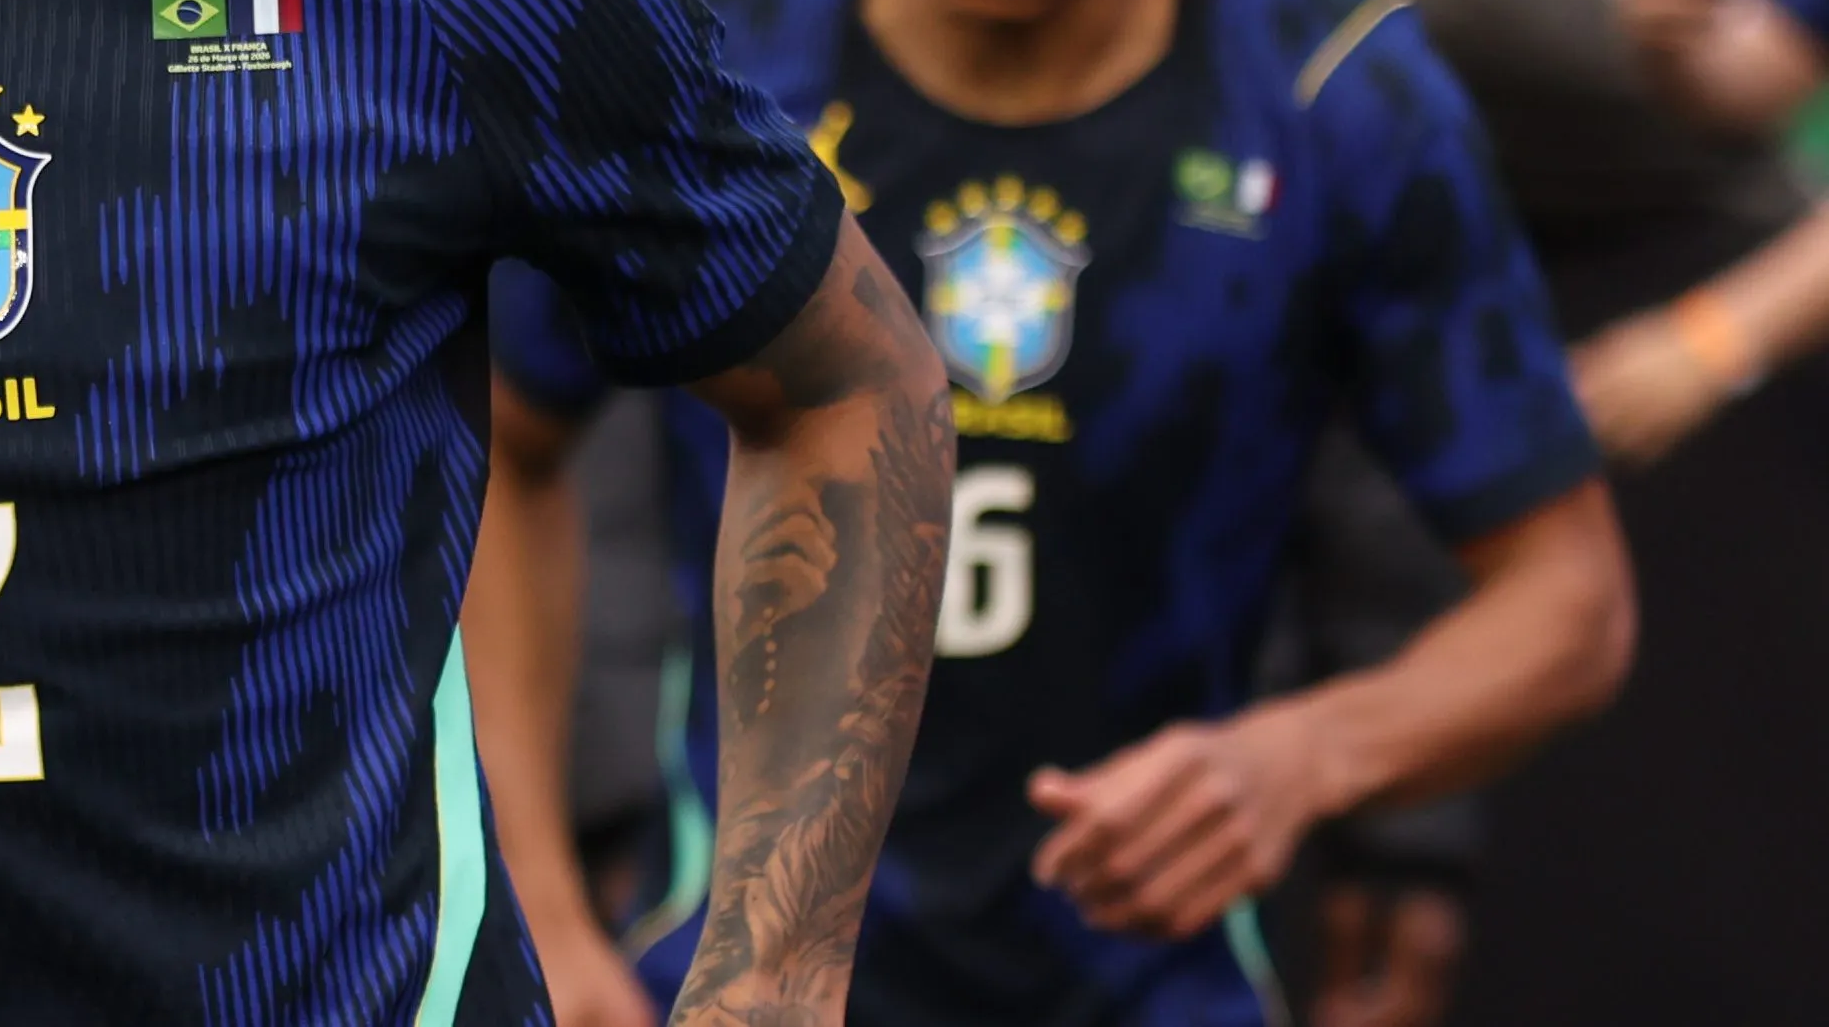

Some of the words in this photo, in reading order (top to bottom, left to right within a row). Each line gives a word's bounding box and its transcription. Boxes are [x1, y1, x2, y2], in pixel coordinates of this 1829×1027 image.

[190, 44, 221, 53] BRASIL
[200, 54, 211, 63] de
[238, 53, 249, 61] de
[167, 64, 200, 73] Gillette
[201, 63, 236, 72] Stadium
[242, 60, 292, 71] Foxborough
[934, 463, 1037, 659] 6
